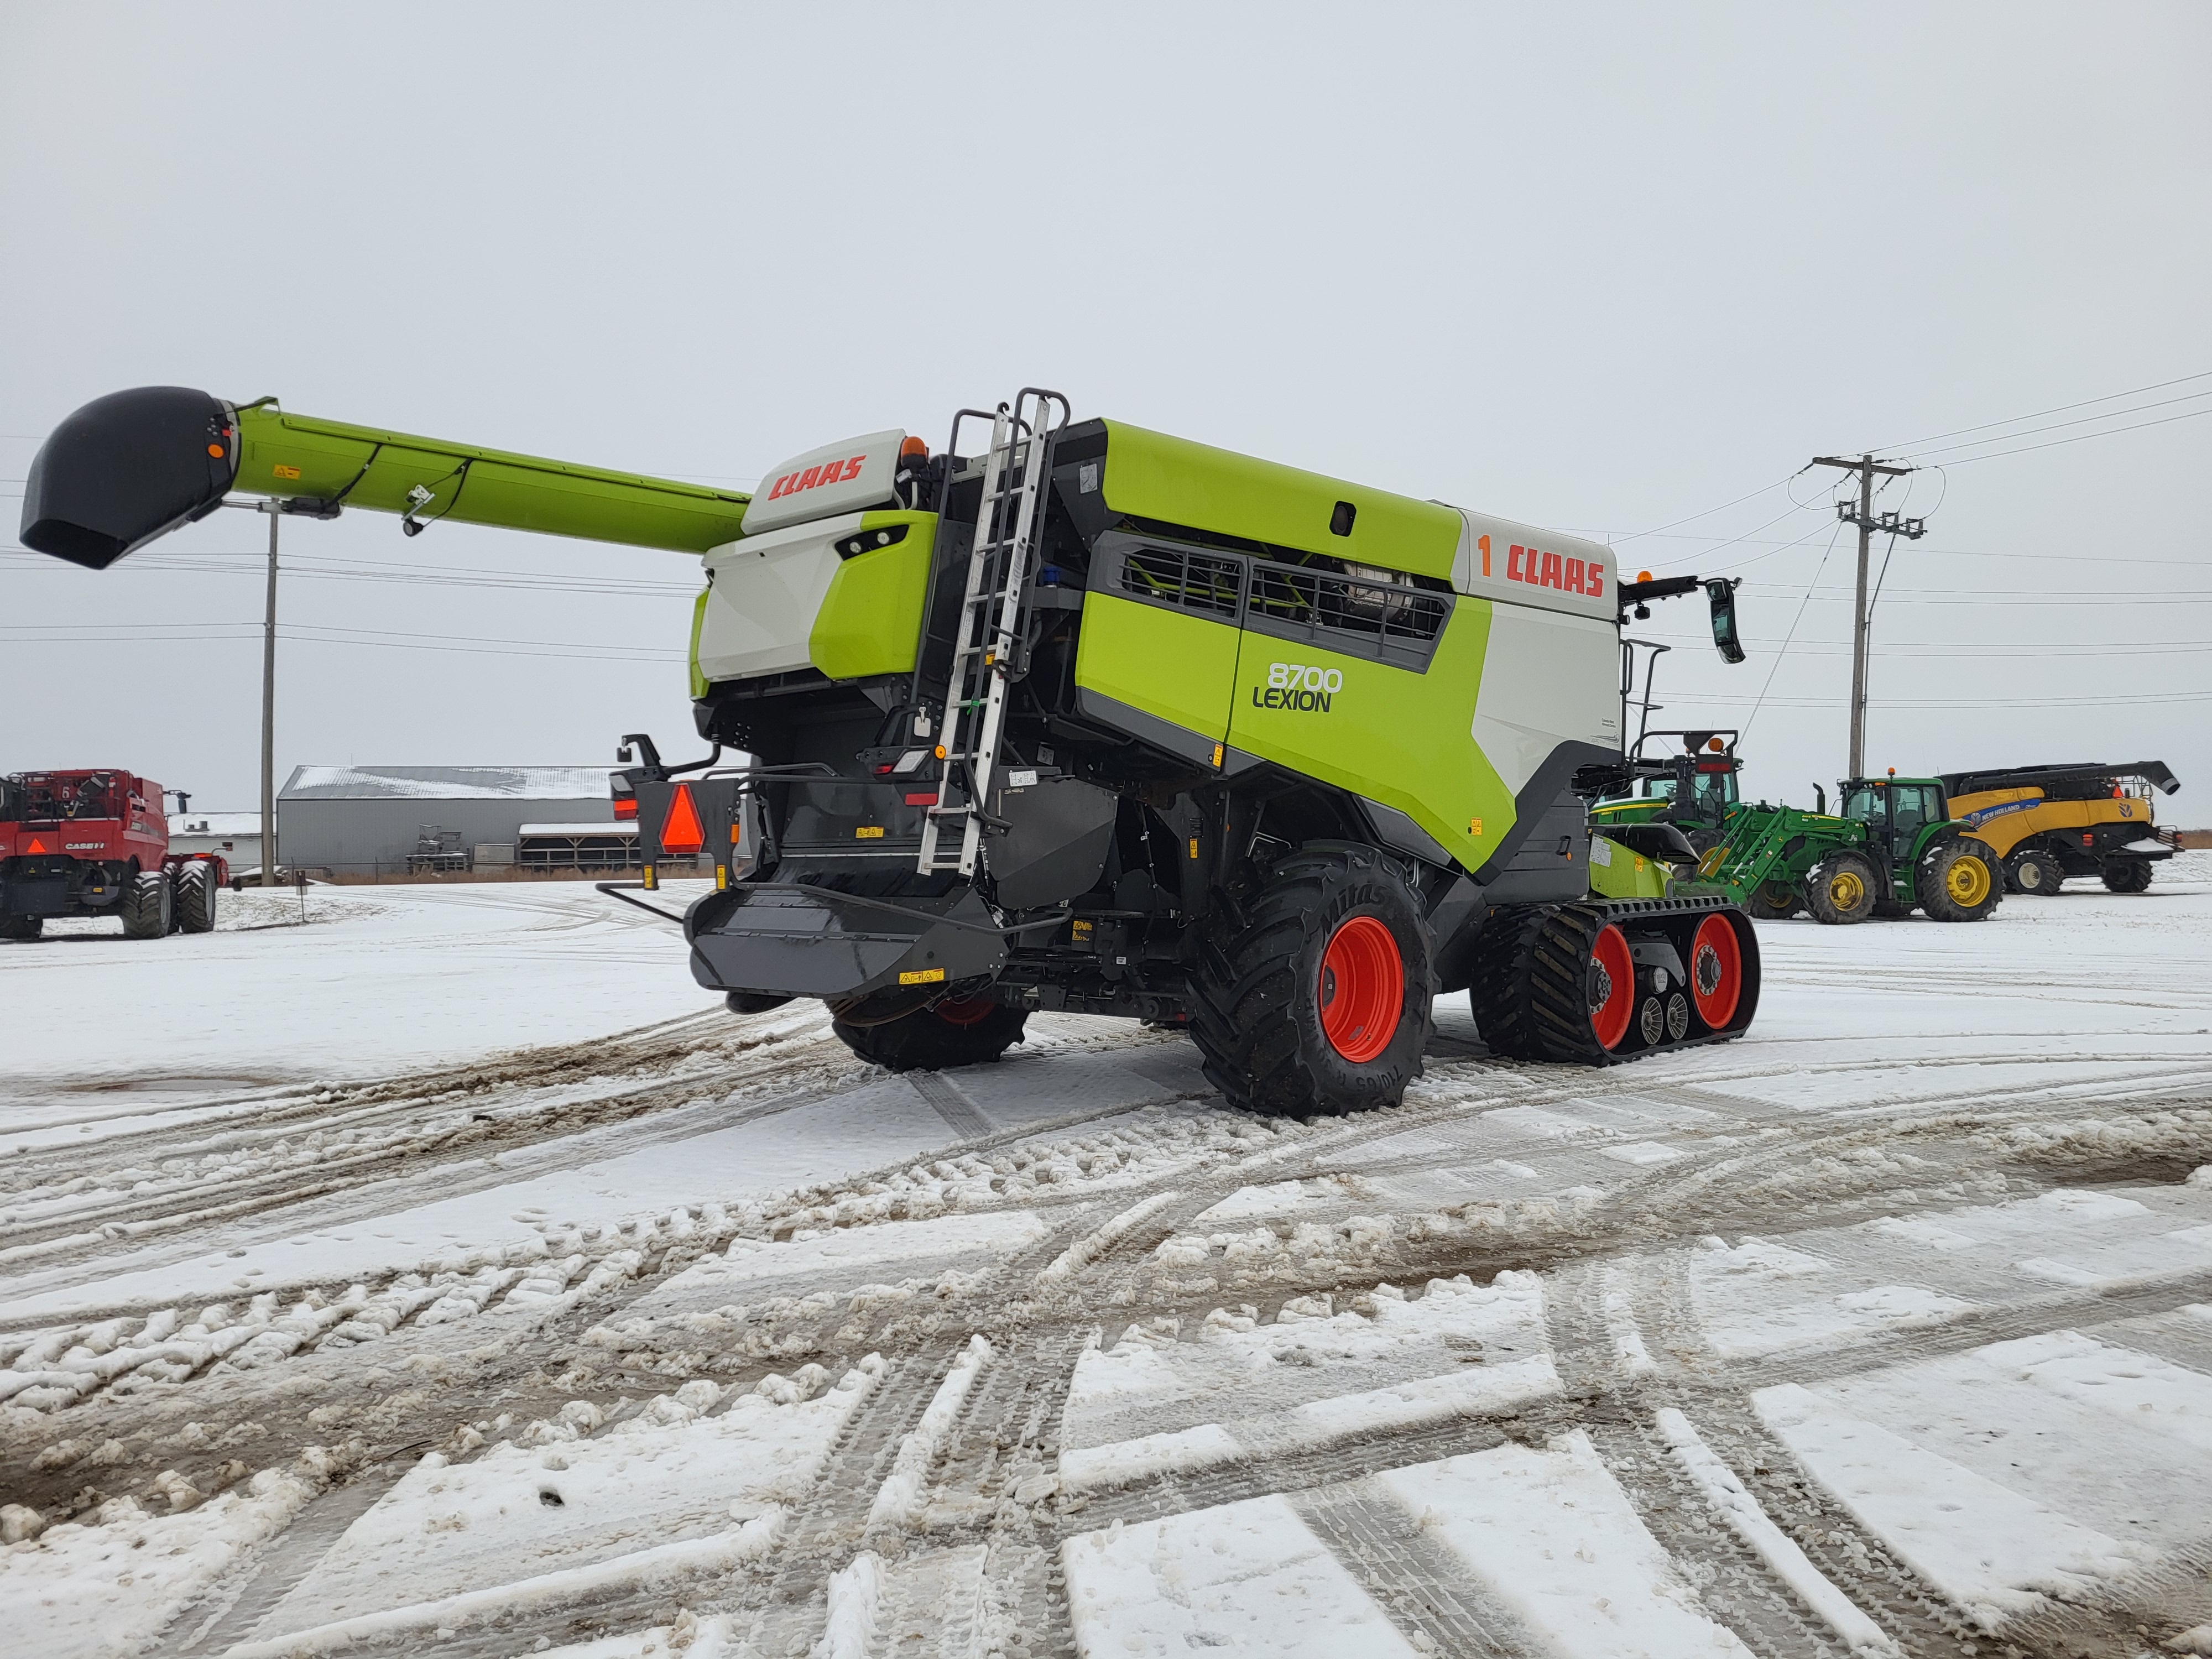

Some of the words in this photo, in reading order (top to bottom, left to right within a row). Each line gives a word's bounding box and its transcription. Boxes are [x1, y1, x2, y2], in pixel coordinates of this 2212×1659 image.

[768, 455, 867, 500] CLAAS
[1478, 534, 1491, 577] 1
[1506, 544, 1604, 598] CLAAS
[1267, 662, 1343, 693] 8700
[1252, 686, 1332, 713] LEXION
[62, 786, 70, 799] 6
[1982, 811, 1994, 821] NEW
[1994, 805, 2020, 816] HOLLAND
[1321, 883, 1385, 948] Mitas
[1355, 1065, 1404, 1091] 710/65
